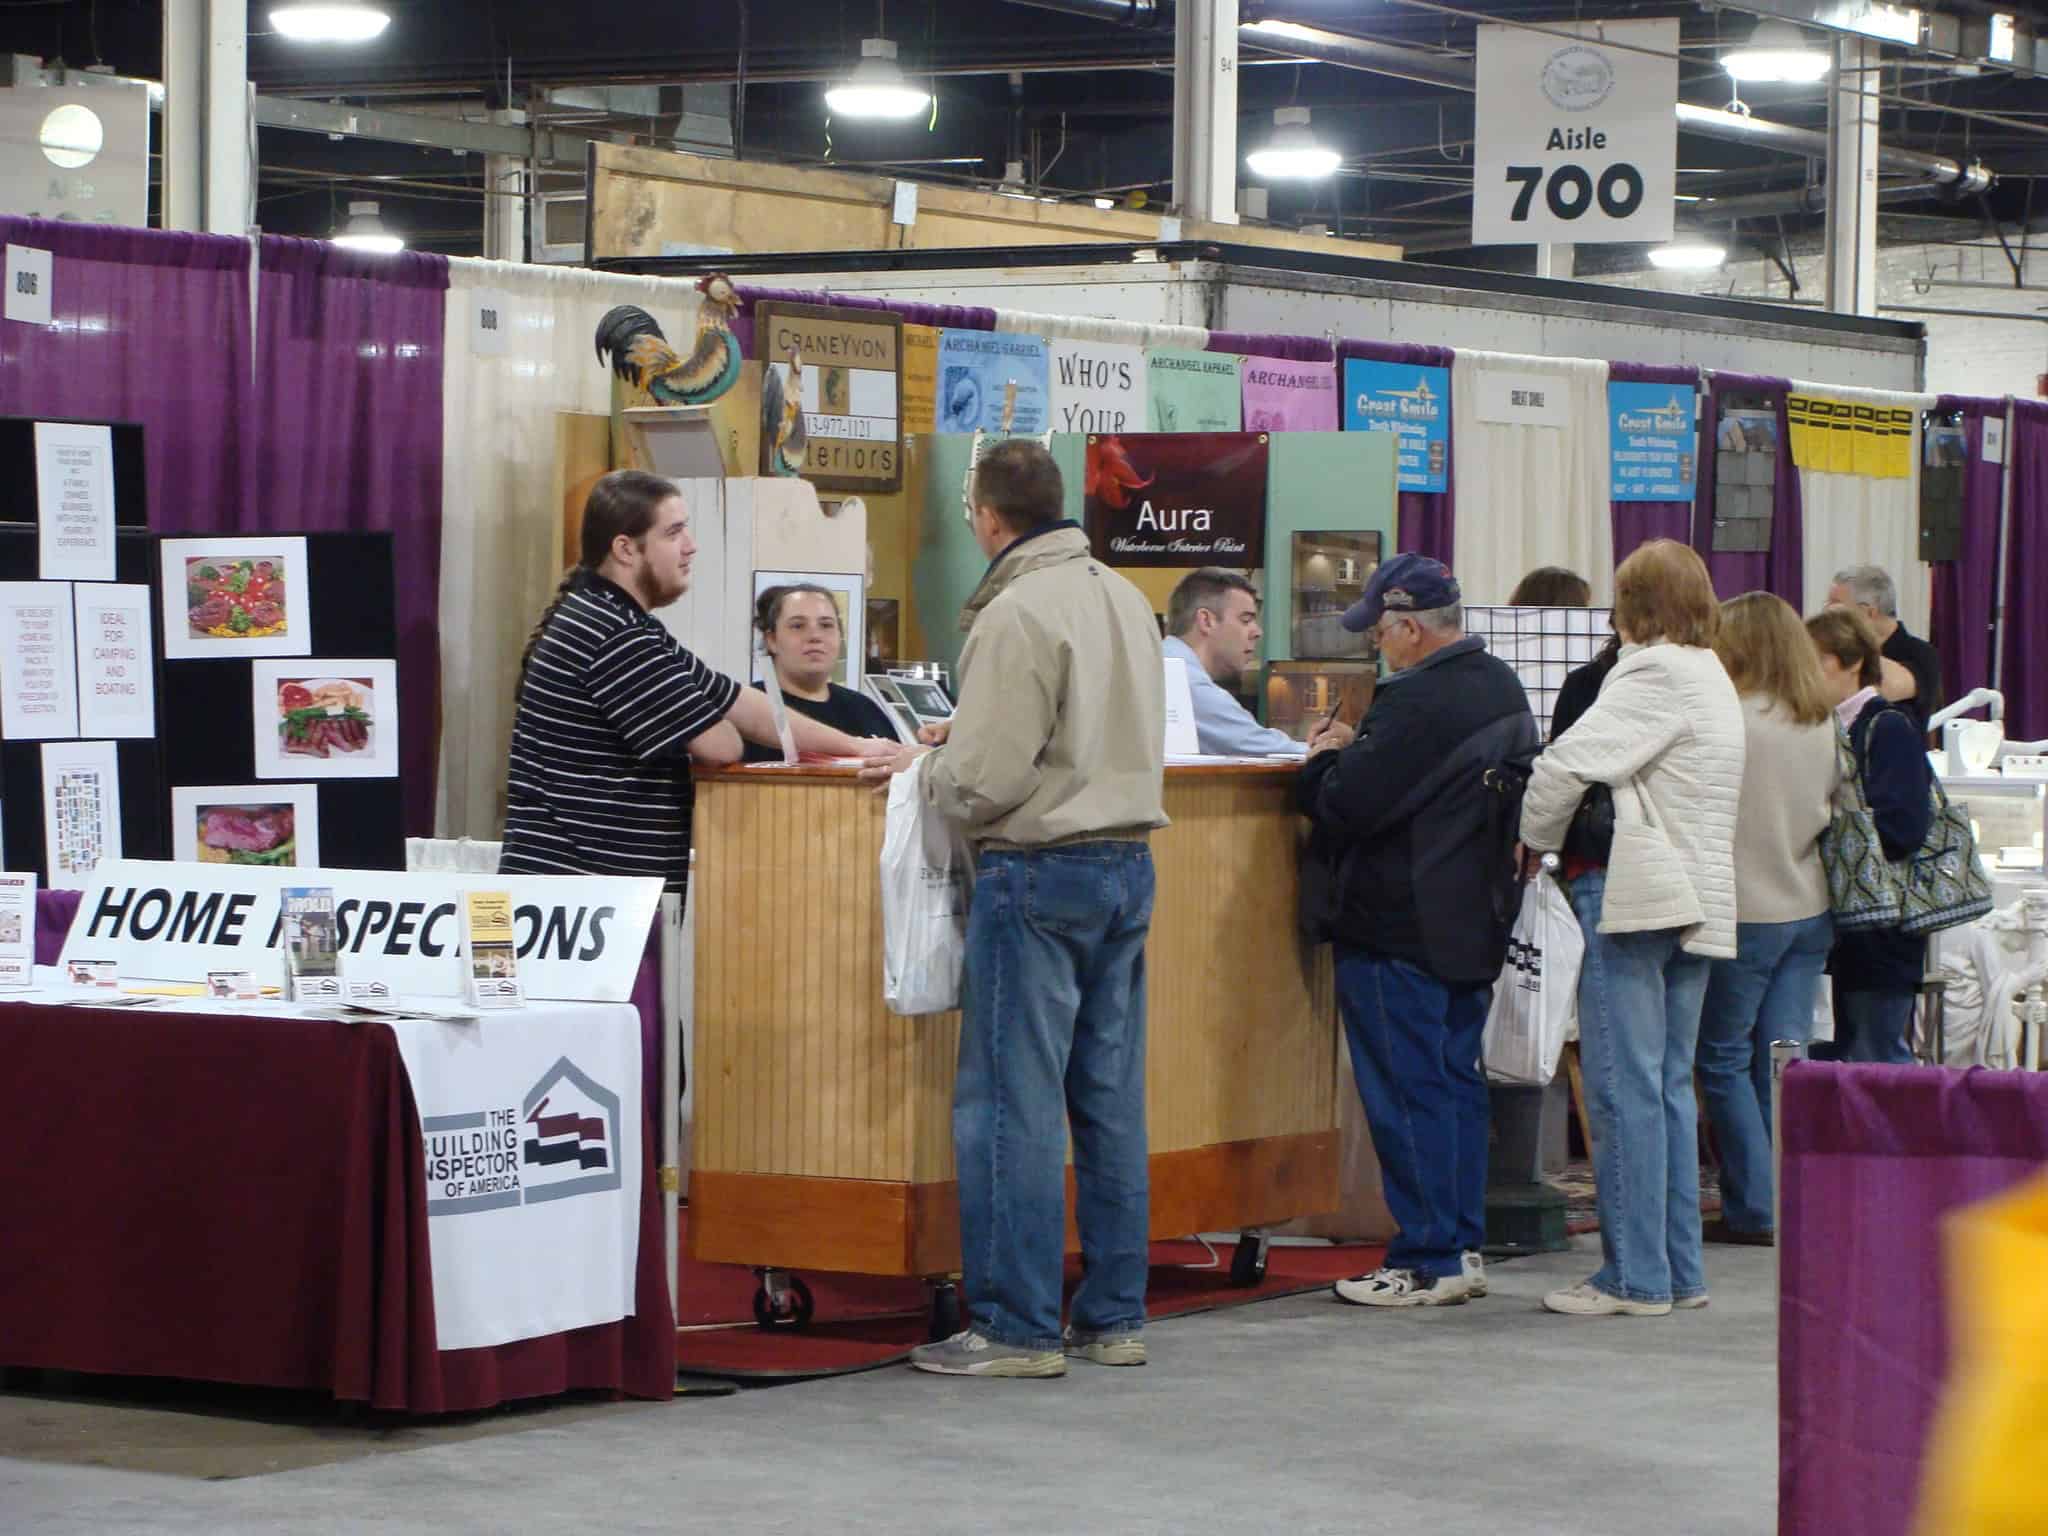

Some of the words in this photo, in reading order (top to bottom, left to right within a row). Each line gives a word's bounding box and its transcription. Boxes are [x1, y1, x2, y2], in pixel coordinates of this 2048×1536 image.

[1546, 127, 1606, 151] Aisle
[1506, 162, 1643, 221] 700
[1058, 352, 1132, 391] WHO'S
[1151, 356, 1201, 372] ARCHANGEL
[1063, 400, 1127, 432] YOUR
[1136, 501, 1211, 532] Aura
[1167, 537, 1211, 553] Interior
[1212, 536, 1246, 553] Paint
[101, 612, 127, 625] IDEAL
[104, 630, 124, 642] FOR
[95, 647, 136, 660] CAMPING
[106, 665, 126, 678] AND
[95, 682, 136, 695] BOATING
[87, 886, 257, 946] HOME
[264, 897, 616, 961] ISPECONS
[490, 1109, 516, 1126] THE
[424, 1129, 518, 1158] UILDING
[445, 1182, 465, 1198] OF
[469, 1175, 520, 1195] AMERICA
